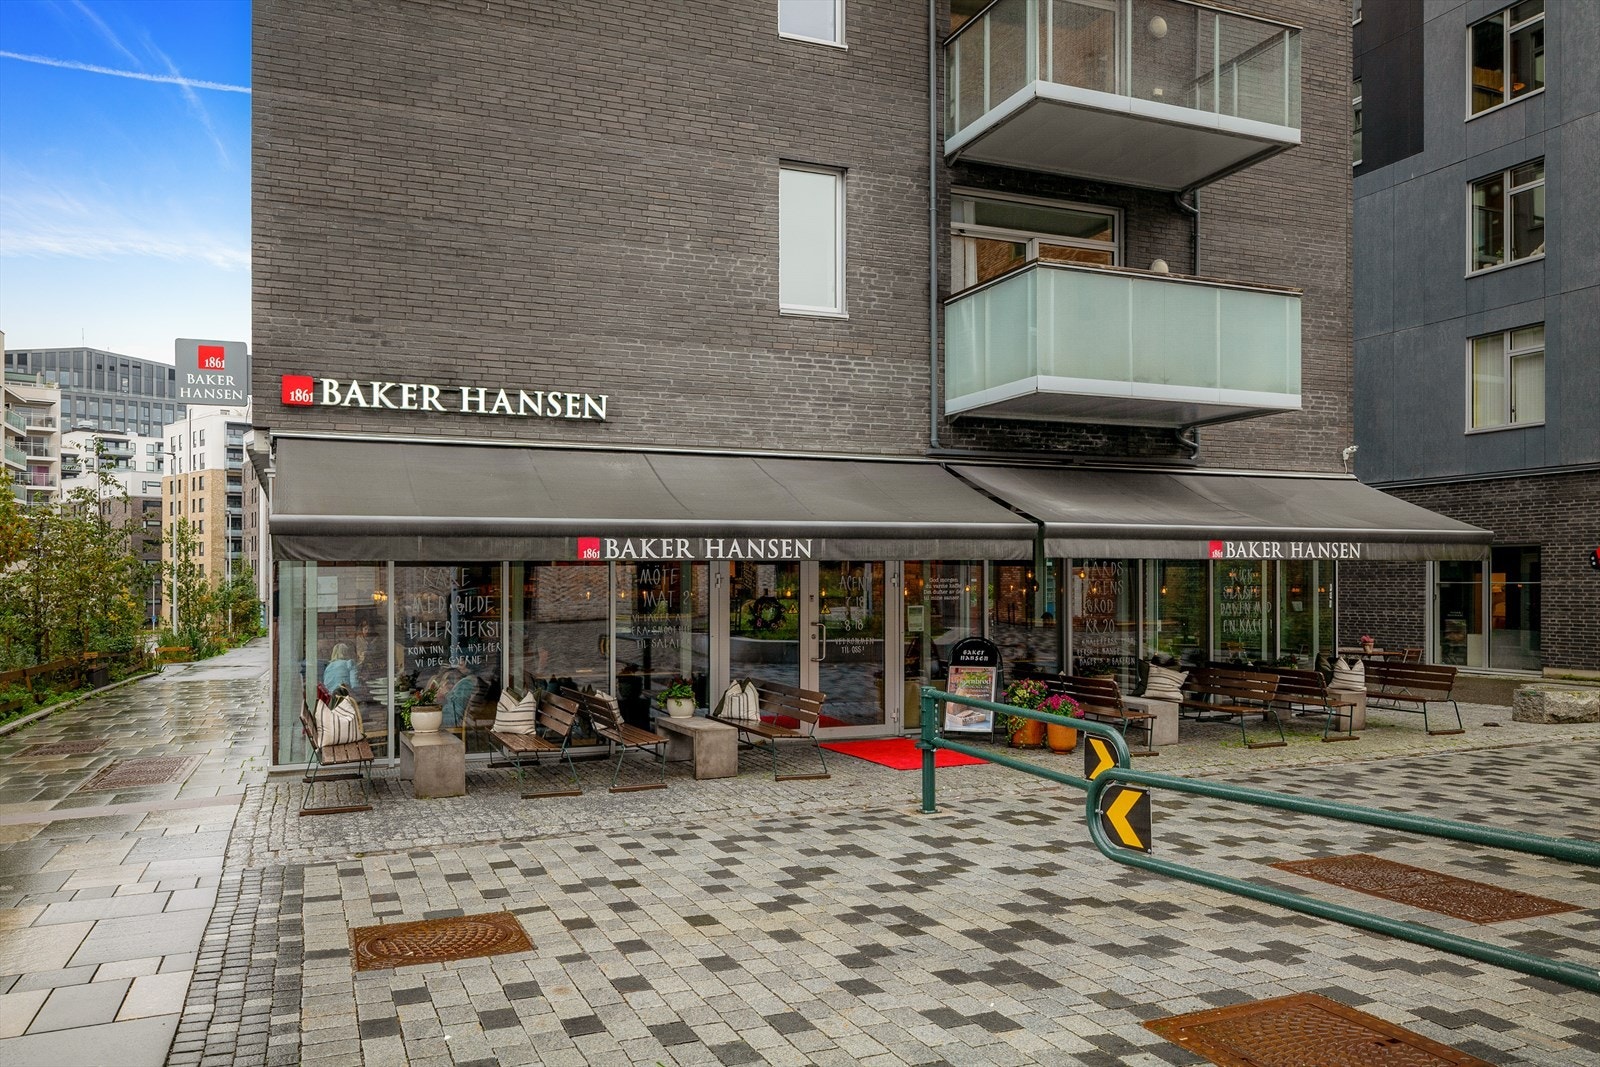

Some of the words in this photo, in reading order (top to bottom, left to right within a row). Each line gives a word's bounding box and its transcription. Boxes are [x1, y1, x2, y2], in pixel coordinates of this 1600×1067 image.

[204, 356, 225, 368] 1861
[187, 373, 236, 386] BAKER
[180, 387, 243, 400] HANSEN
[289, 388, 313, 403] 1861
[319, 377, 447, 412] BAKER
[459, 386, 609, 420] HANSEN
[583, 549, 600, 559] 1861
[604, 538, 695, 559] BAKER
[705, 538, 813, 559] HANSEN
[1212, 549, 1223, 558] 1861
[1225, 541, 1284, 558] BAKER
[1290, 542, 1361, 559] HANSEN
[643, 590, 676, 608] MAT
[1254, 601, 1272, 614] MD
[676, 613, 690, 622] AT
[408, 620, 456, 640] ELLER
[1086, 618, 1100, 634] KR
[1101, 618, 1115, 634] 20
[1239, 619, 1266, 633] KAFF
[407, 646, 427, 656] KOM
[427, 657, 443, 667] DEG
